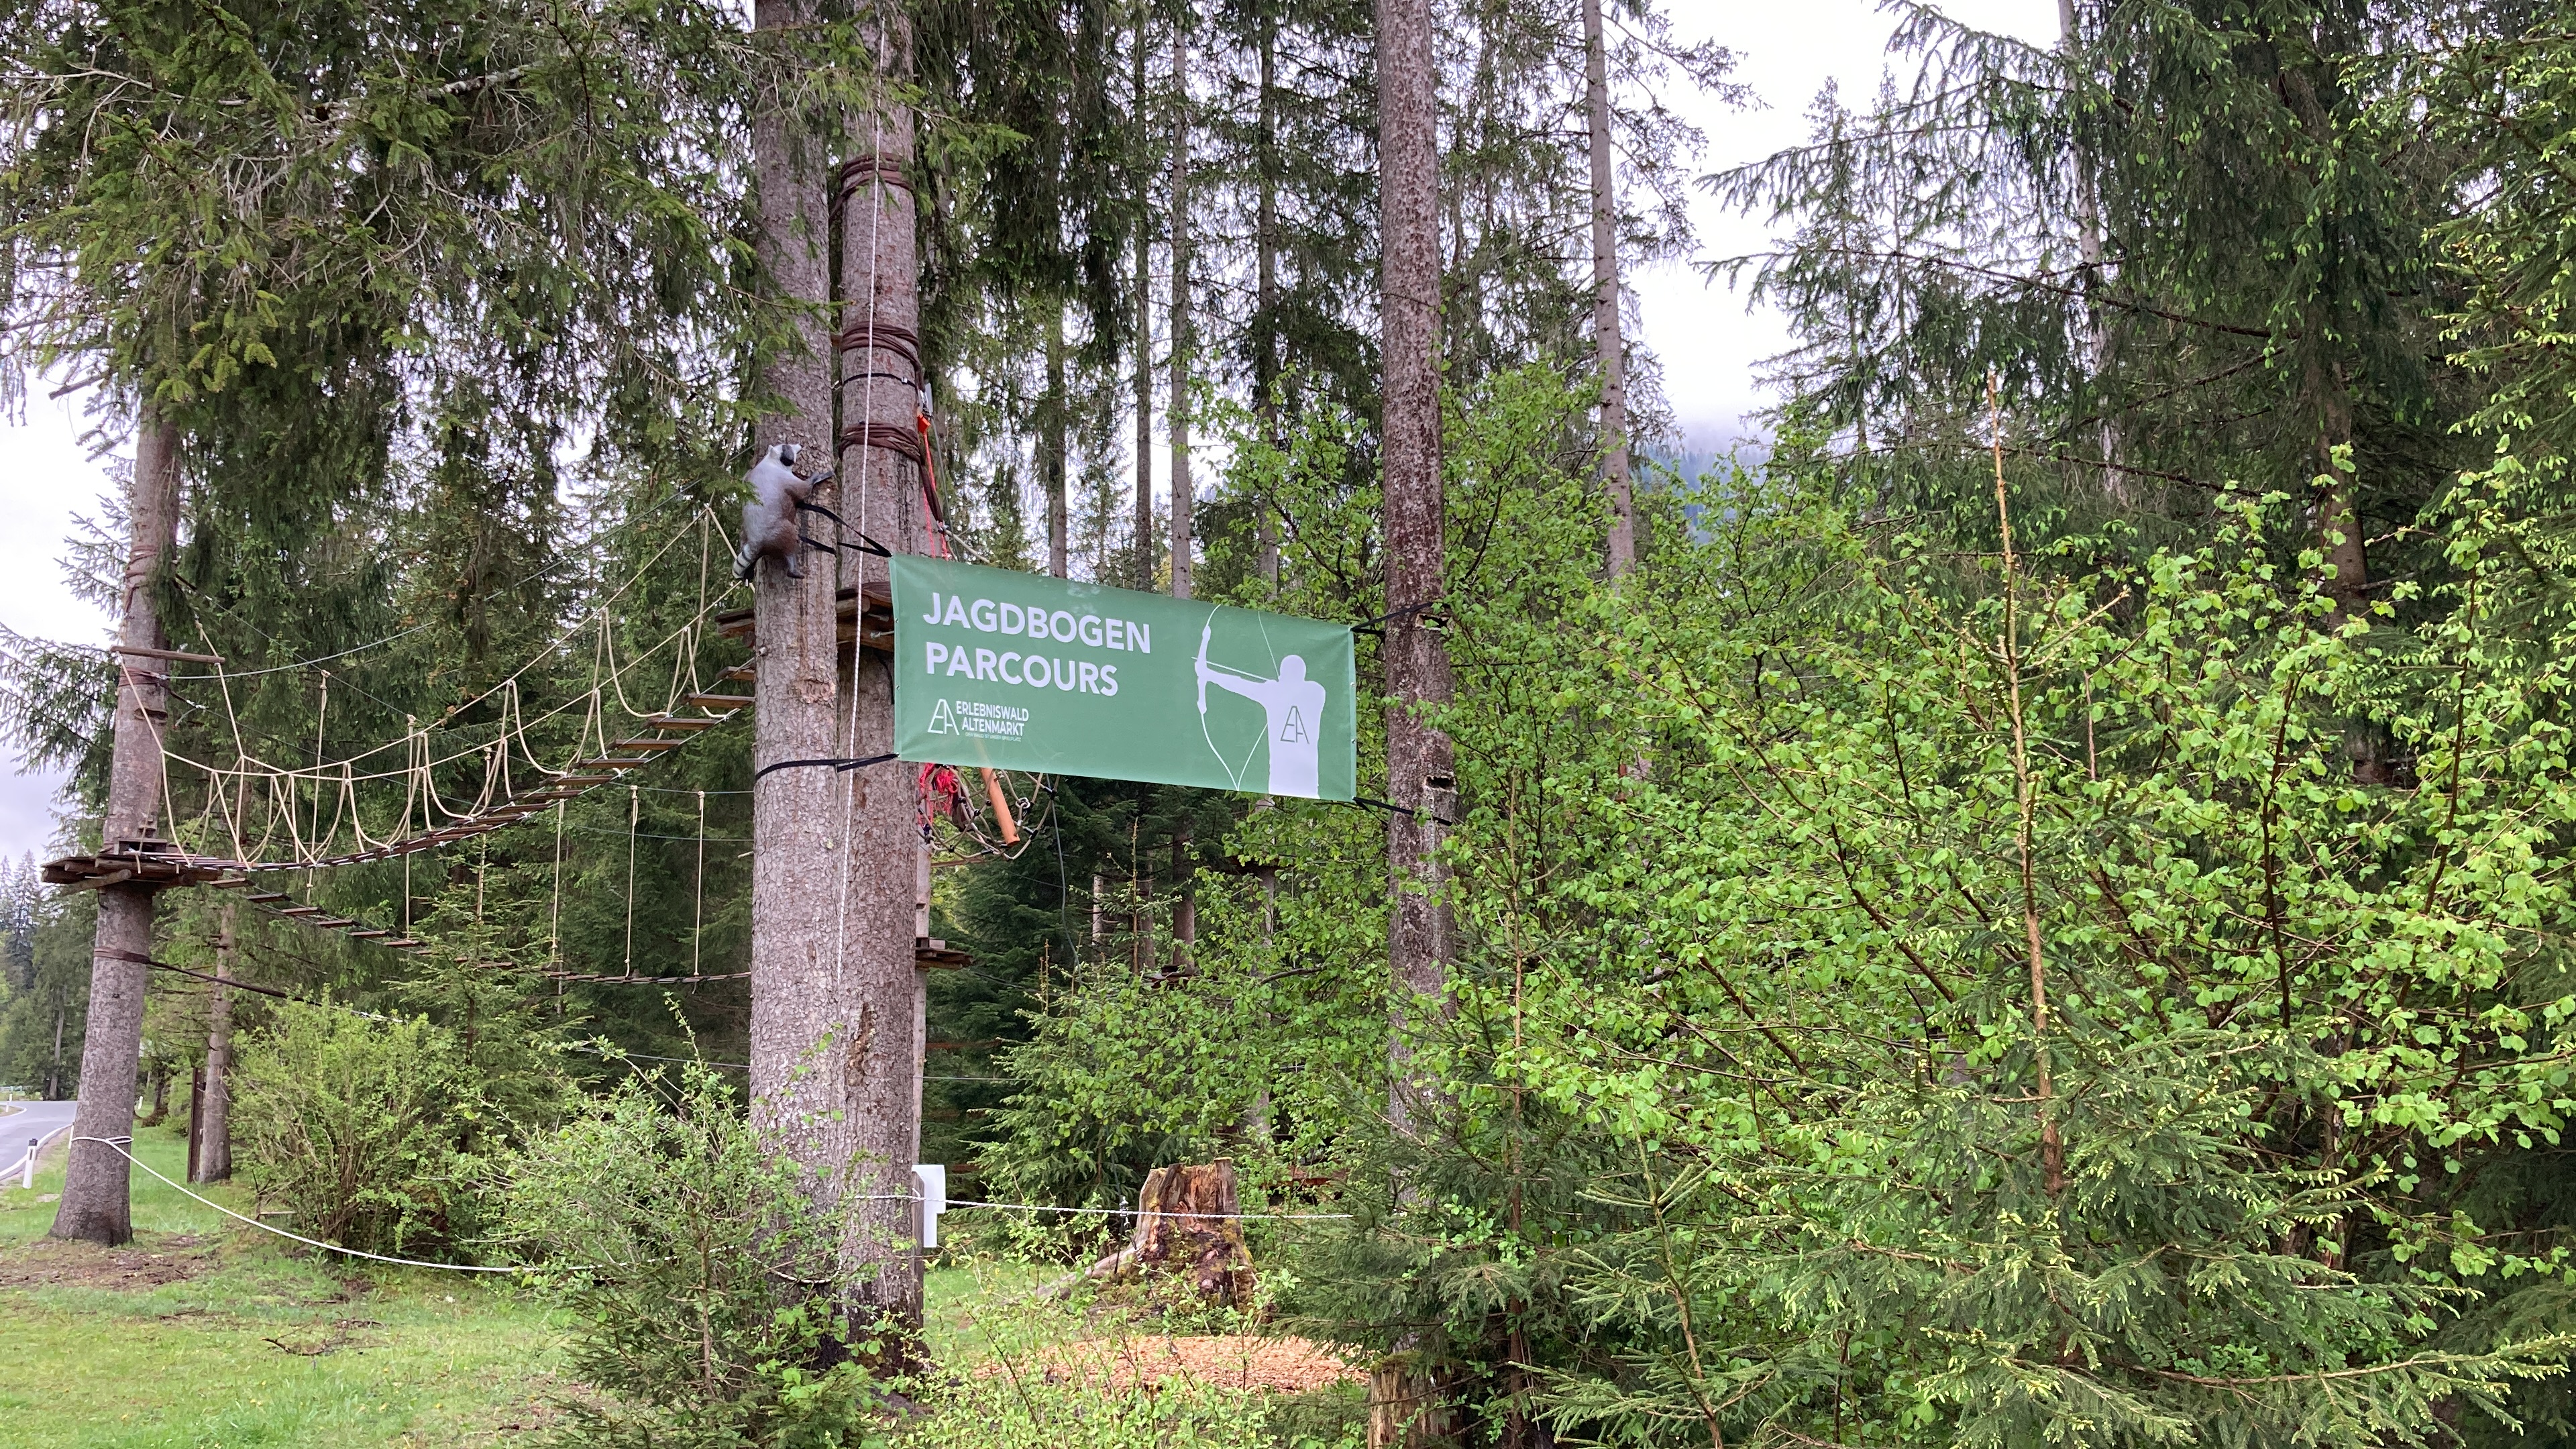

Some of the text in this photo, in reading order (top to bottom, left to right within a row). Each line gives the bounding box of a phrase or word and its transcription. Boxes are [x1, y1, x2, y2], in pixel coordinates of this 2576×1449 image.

[923, 592, 1151, 654] JAGDBOGEN
[926, 642, 1118, 696] PARCOURS
[955, 700, 1029, 722] ERLEBNISWALD
[961, 716, 1025, 737] ALTENMARKT
